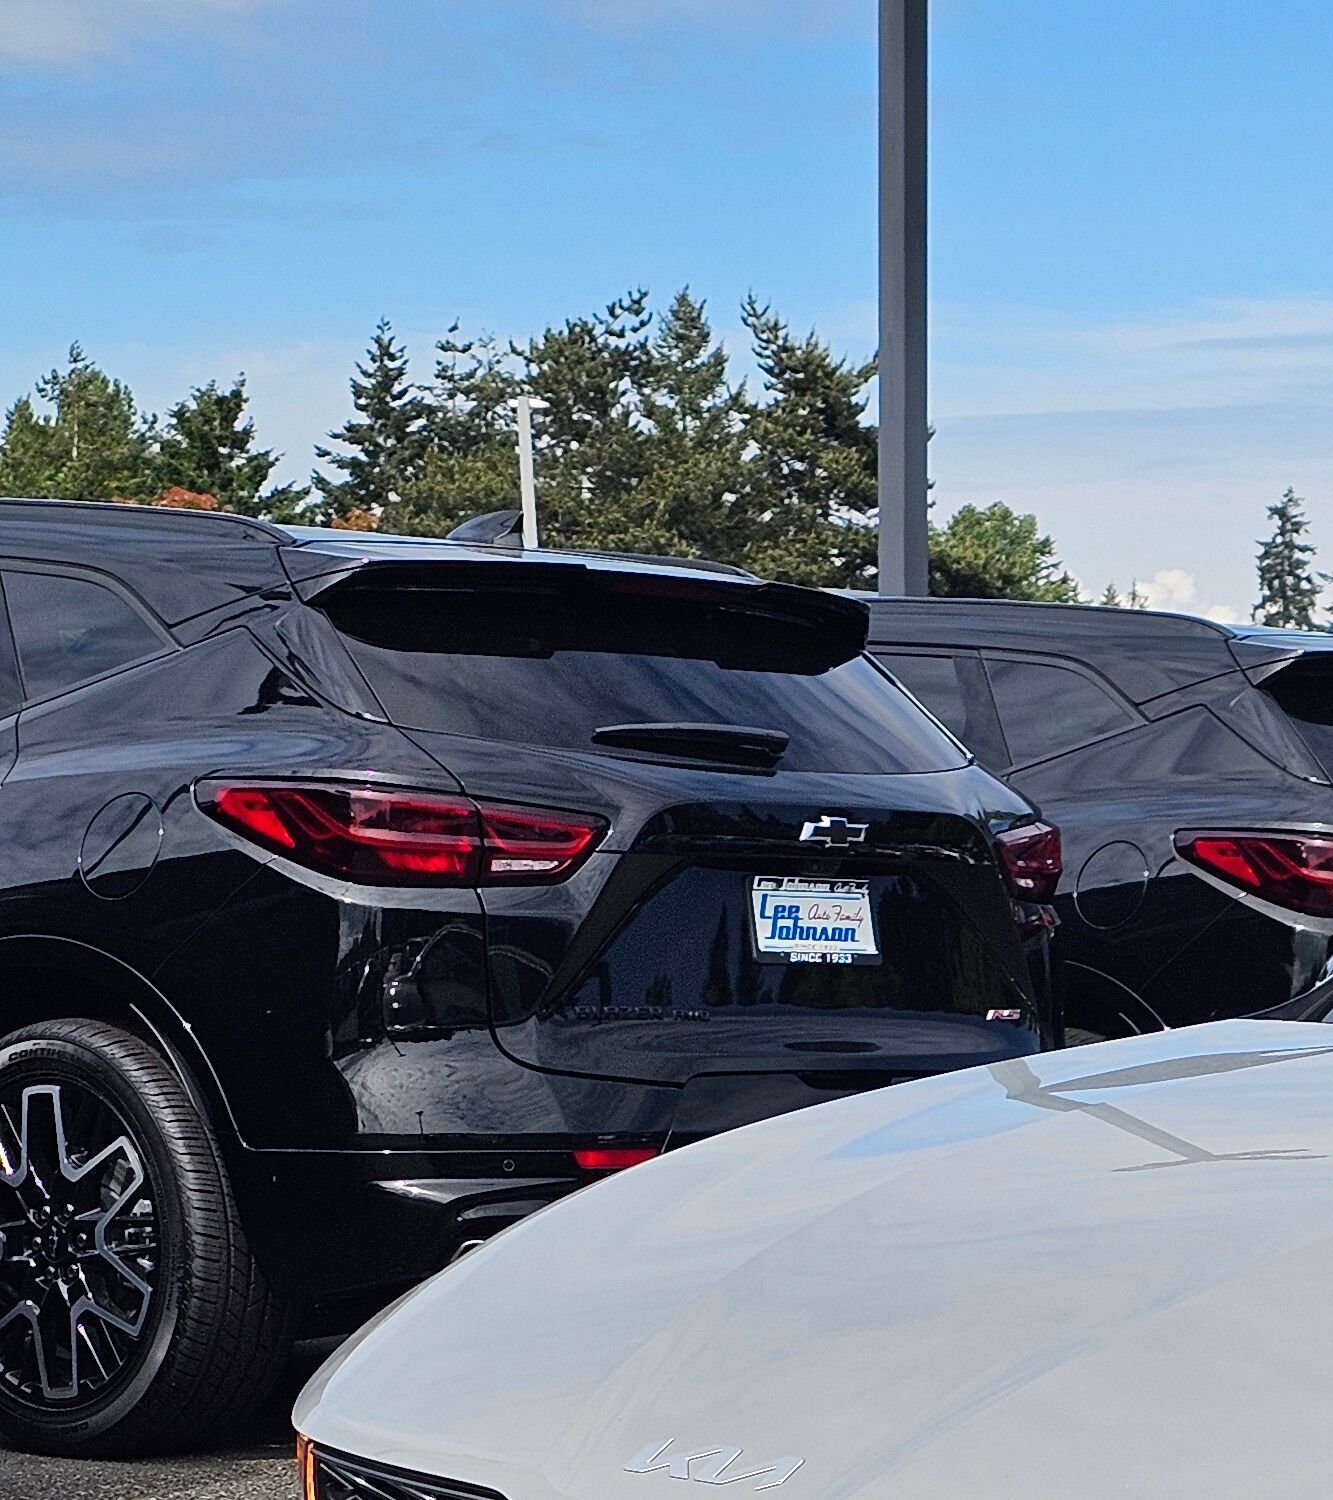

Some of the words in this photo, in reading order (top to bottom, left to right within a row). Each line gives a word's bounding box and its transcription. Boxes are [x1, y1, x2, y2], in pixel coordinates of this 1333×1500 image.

[759, 893, 804, 920] Lee
[765, 915, 860, 942] Johnson
[789, 953, 823, 963] SINCE
[825, 953, 853, 964] 1933
